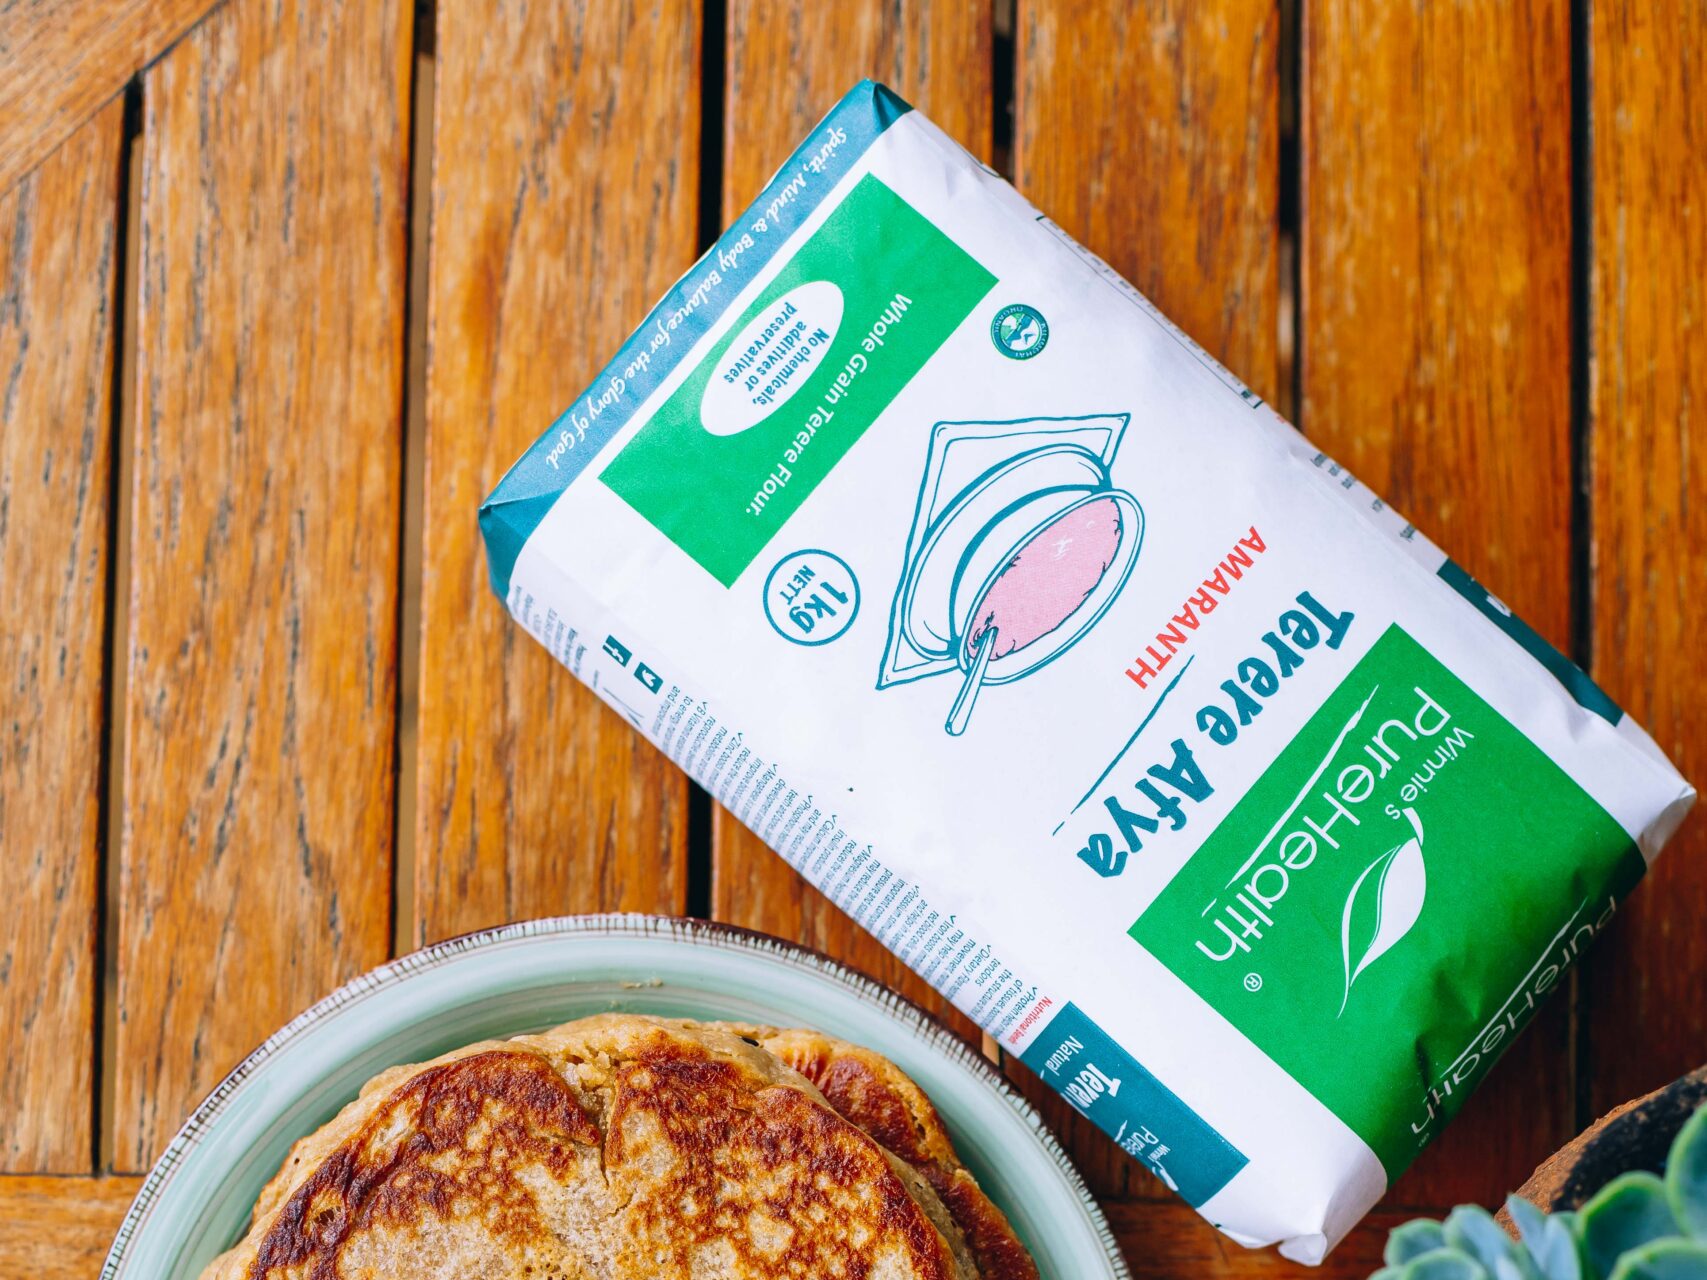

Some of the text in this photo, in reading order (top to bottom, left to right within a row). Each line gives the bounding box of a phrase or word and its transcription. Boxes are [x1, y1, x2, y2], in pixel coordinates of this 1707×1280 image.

[802, 127, 846, 172] Spirit,
[765, 172, 806, 223] Mind
[717, 232, 754, 272] Body
[666, 269, 721, 331] Balance
[649, 319, 673, 353] for
[723, 301, 797, 383] preservatives
[755, 321, 806, 375] additives
[624, 351, 650, 379] the
[752, 345, 810, 405] chemicals,
[586, 375, 625, 420] Glory
[745, 293, 912, 515] Whole Grain Terere Flour.
[570, 413, 589, 441] of
[545, 430, 575, 469] God
[779, 564, 815, 605] NETT
[1125, 526, 1266, 689] AMARANTH
[1076, 590, 1354, 877] Terere Afya
[1195, 686, 1451, 961] PureHealth
[962, 947, 990, 975] Dietary
[973, 957, 1001, 988] tendons
[1010, 990, 1035, 1016] Protein
[1018, 995, 1053, 1032] Nutritional
[1045, 1035, 1083, 1075] Natural
